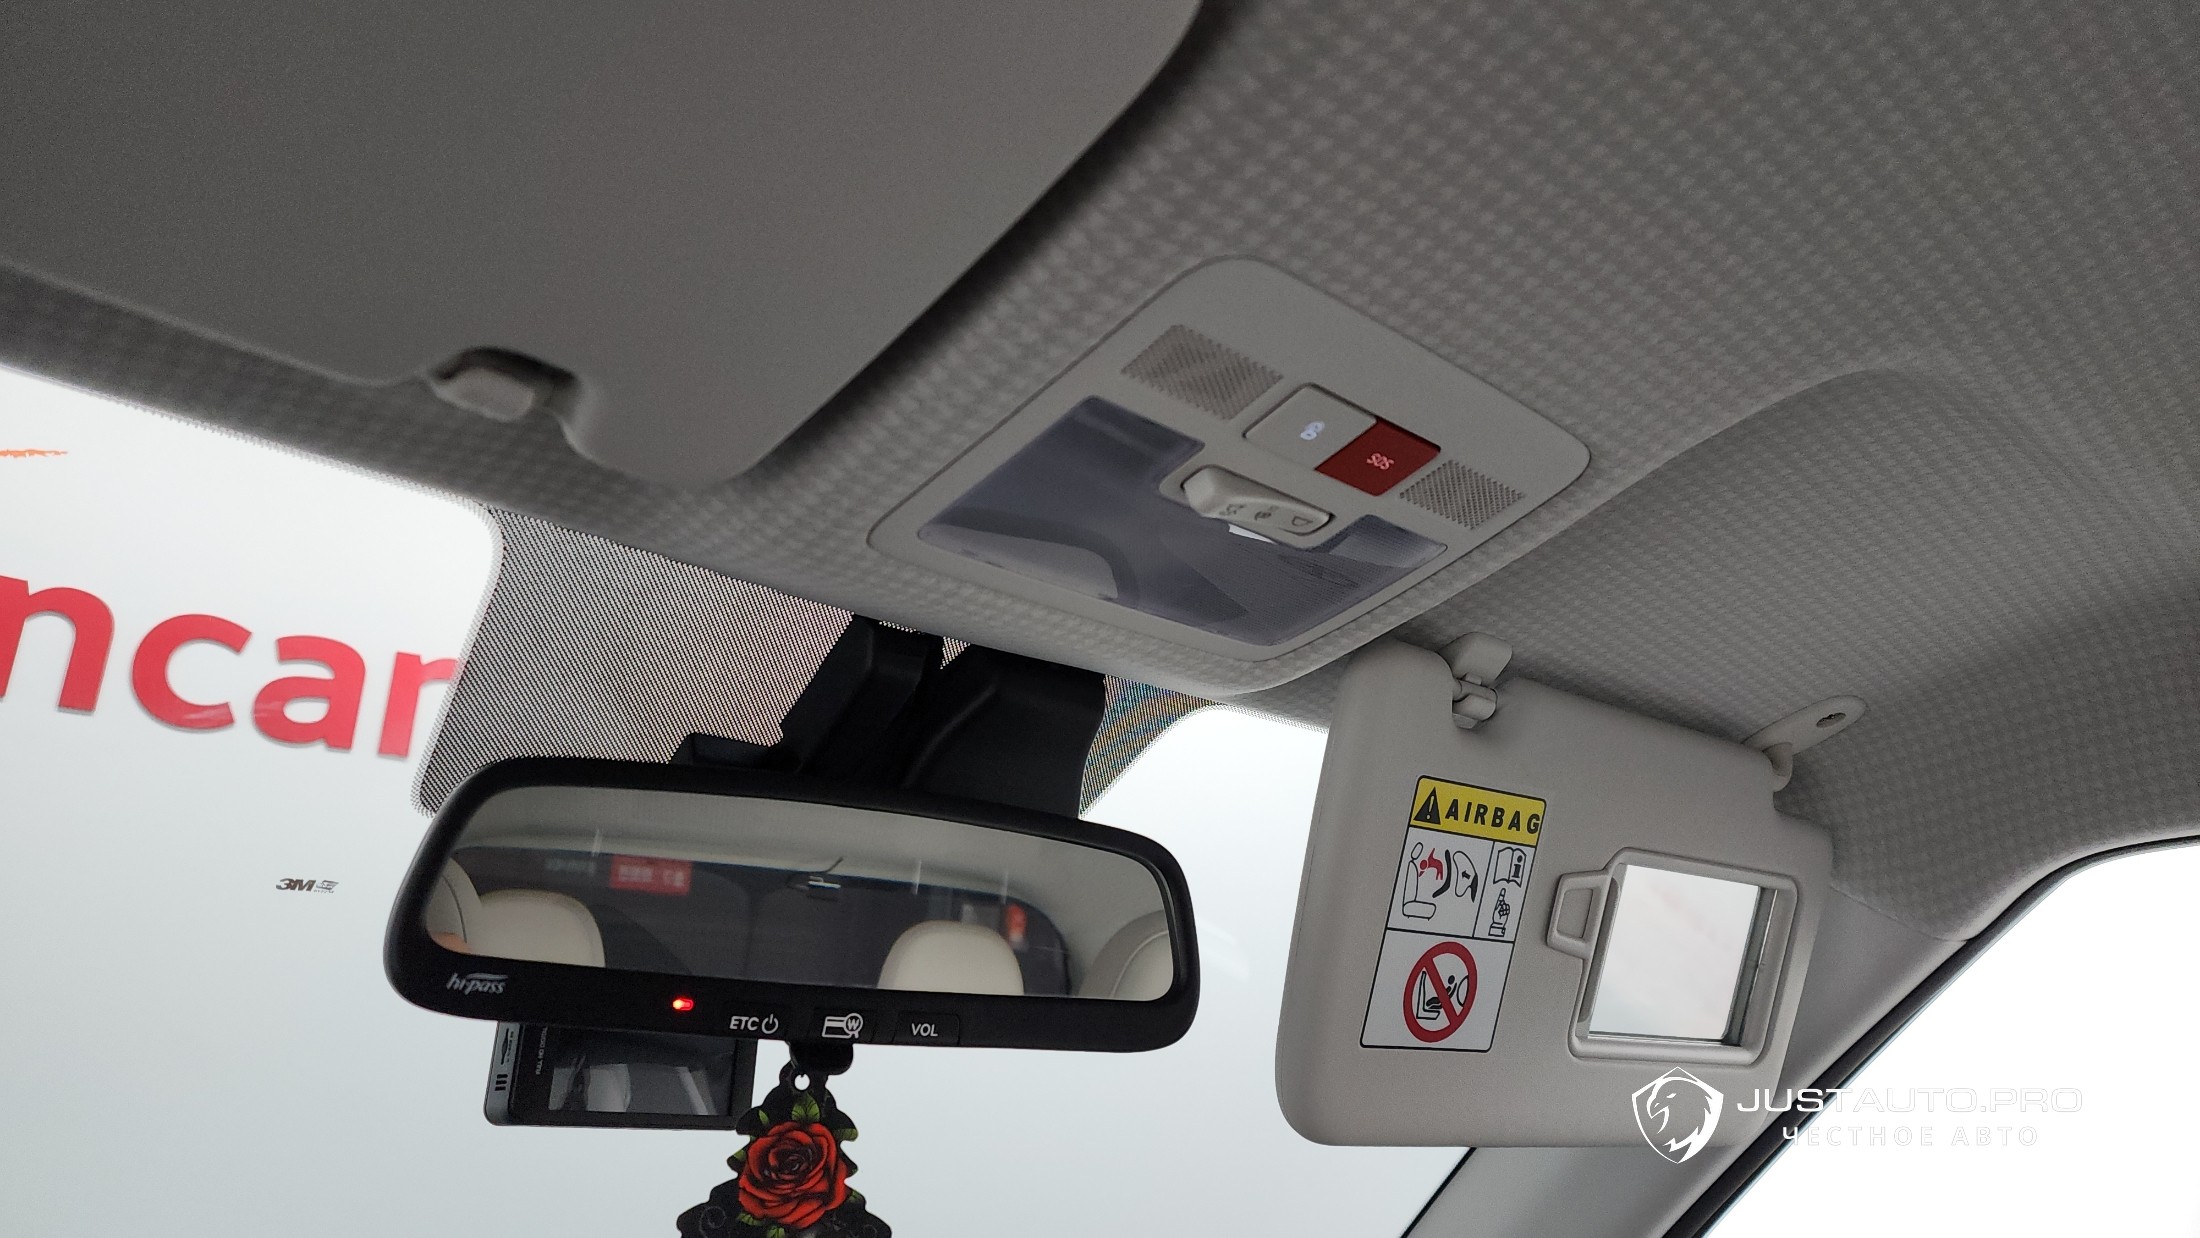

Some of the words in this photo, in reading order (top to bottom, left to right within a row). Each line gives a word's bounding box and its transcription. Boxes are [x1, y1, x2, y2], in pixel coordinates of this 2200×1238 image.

[1366, 452, 1395, 471] SOS
[1445, 799, 1540, 834] AIRBAG
[276, 878, 317, 892] 3M
[729, 1015, 760, 1031] ETC
[911, 1023, 939, 1037] VOL
